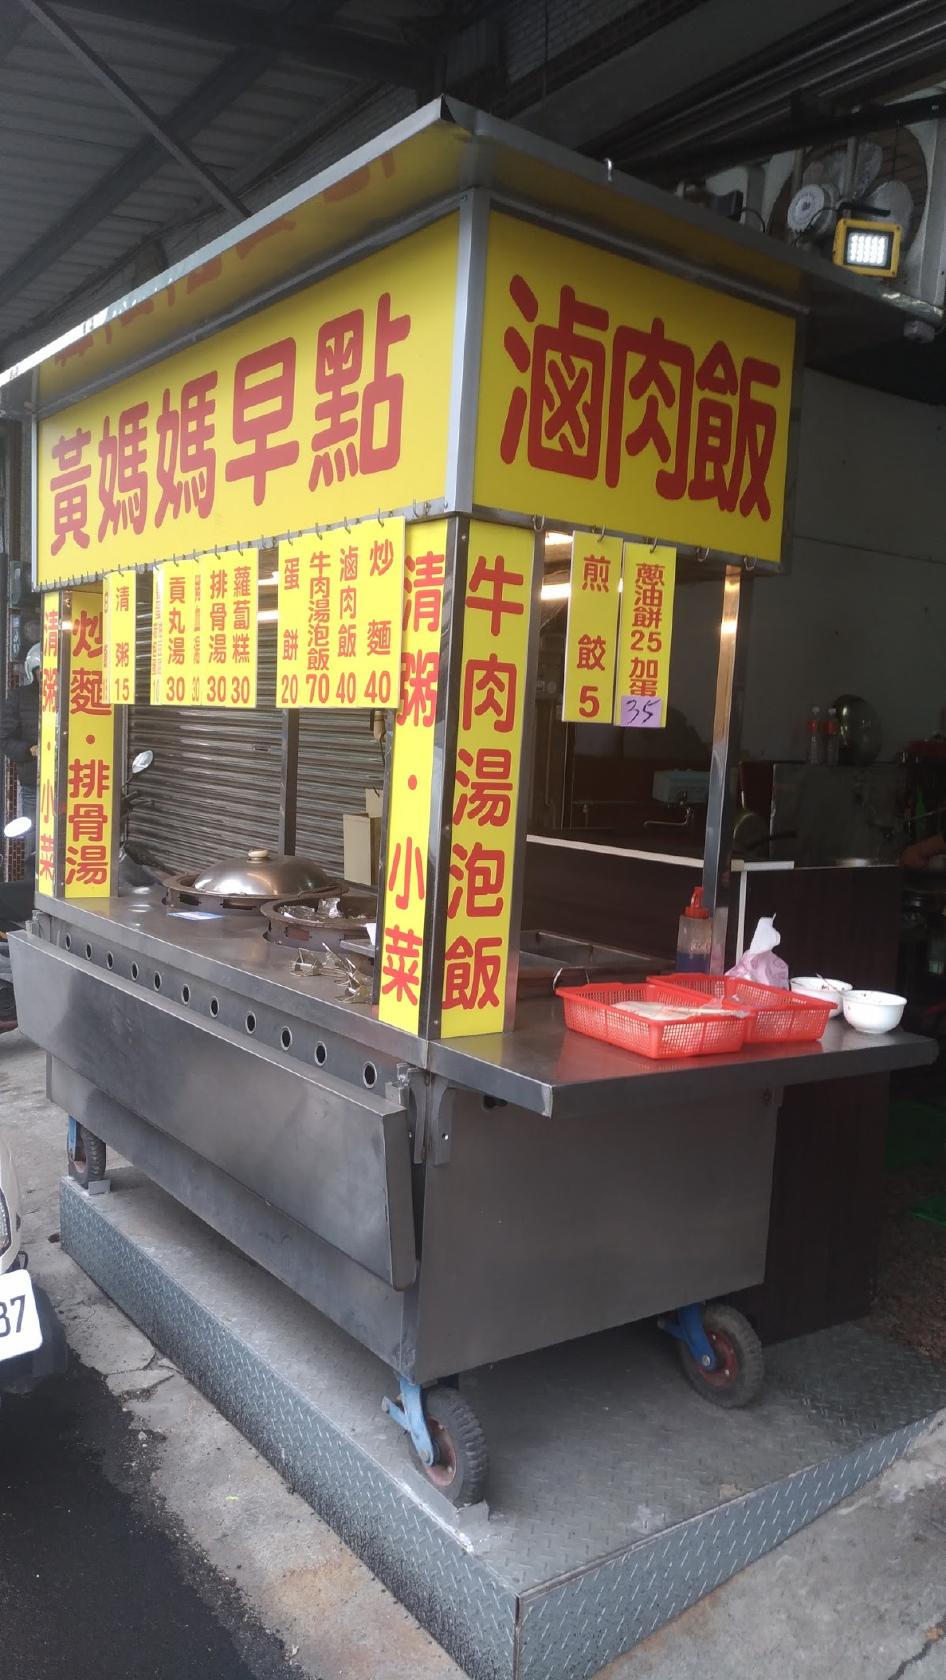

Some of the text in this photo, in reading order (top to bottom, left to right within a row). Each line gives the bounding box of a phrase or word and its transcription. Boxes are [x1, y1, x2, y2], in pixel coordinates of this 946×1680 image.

[50, 292, 411, 556] 黃媽媽早點
[500, 274, 781, 520] 滷肉飯
[115, 586, 129, 701] 清粥 15
[166, 577, 186, 702] 貢丸湯 30
[207, 570, 227, 702] 排骨湯 30
[231, 566, 251, 704] 蘿蔔糕 30
[281, 557, 299, 704] 蛋餅 20
[306, 551, 331, 703] 牛肉湯泡飯 70
[336, 546, 358, 703] 滷肉飯 40
[364, 539, 393, 703] 炒麵 40
[577, 554, 611, 718] 煎餃 5
[441, 555, 525, 1010] 牛肉湯泡飯
